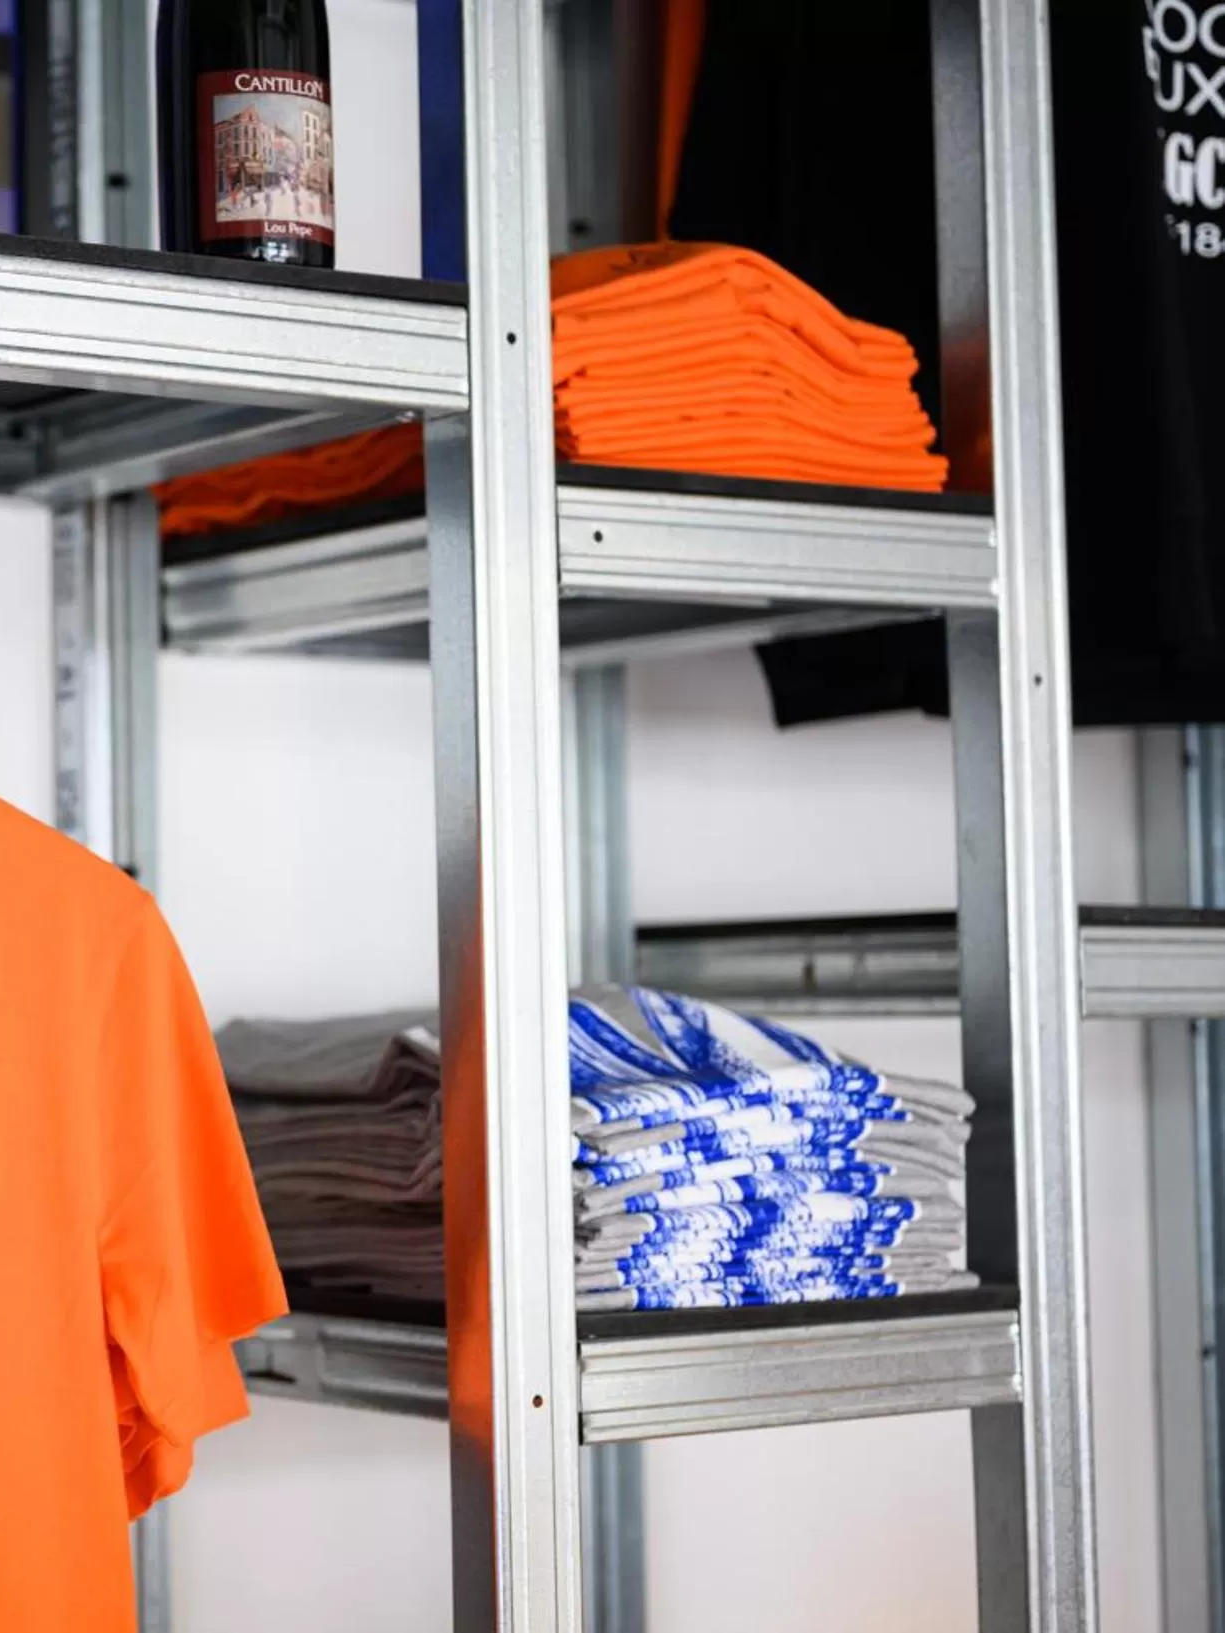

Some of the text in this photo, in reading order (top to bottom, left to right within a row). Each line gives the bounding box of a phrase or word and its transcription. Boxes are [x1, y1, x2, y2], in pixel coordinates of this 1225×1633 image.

[235, 73, 323, 99] CANTILLON
[264, 220, 287, 234] Lou
[1176, 219, 1225, 258] 18
